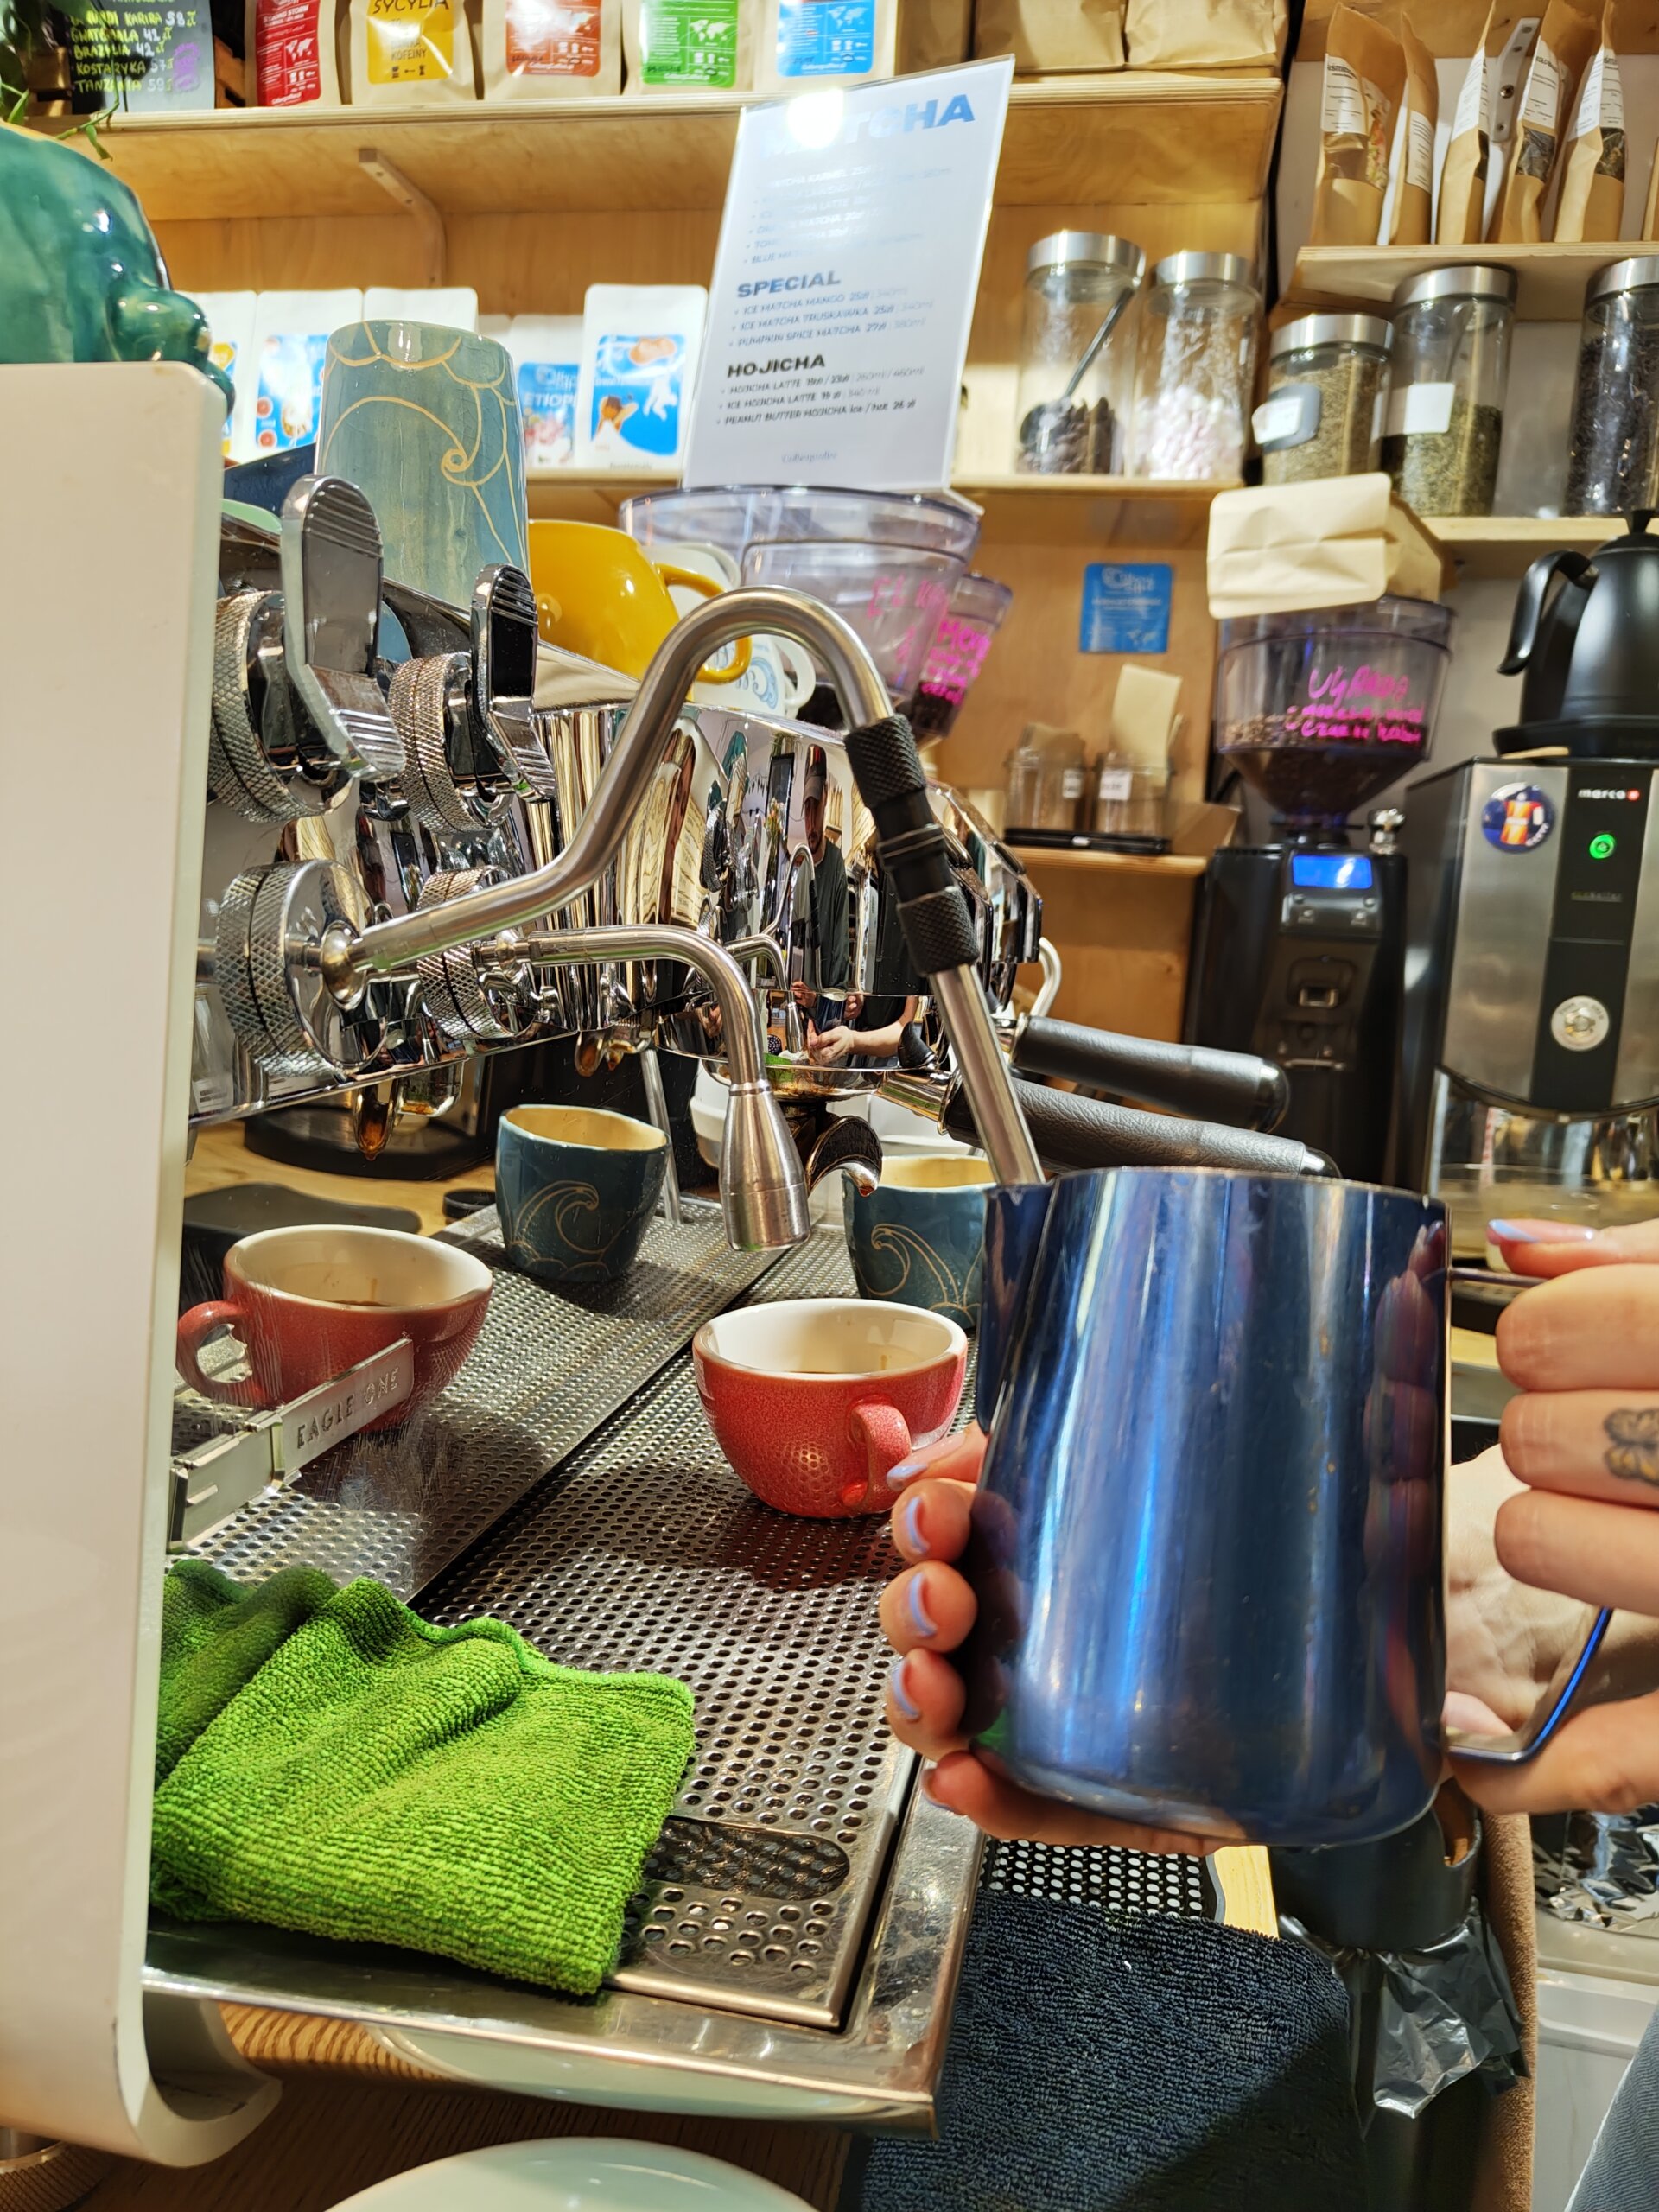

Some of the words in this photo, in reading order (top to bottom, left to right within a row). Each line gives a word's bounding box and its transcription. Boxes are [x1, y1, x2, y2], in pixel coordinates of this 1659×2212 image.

[69, 10, 119, 26] BRUNDI
[76, 60, 146, 75] KOSTARYKA
[738, 270, 841, 298] SPECIAL
[744, 304, 759, 315] ICE
[760, 298, 803, 313] MATCHA
[805, 294, 845, 306] MANGO
[741, 321, 756, 331] ICE
[758, 315, 800, 328] MATCHA
[738, 333, 785, 347] PUMPKIN
[786, 329, 814, 341] SPICE
[816, 324, 861, 337] MATCHA
[727, 353, 826, 378] HOJICHA
[773, 378, 801, 391] LATTE
[728, 400, 741, 410] ICE
[787, 391, 817, 404] LATTE
[724, 414, 763, 426] PEANUT
[765, 410, 802, 423] BUTTER
[1578, 788, 1625, 800] marco
[297, 1394, 355, 1450] EAGLE
[364, 1367, 400, 1406] ONE
